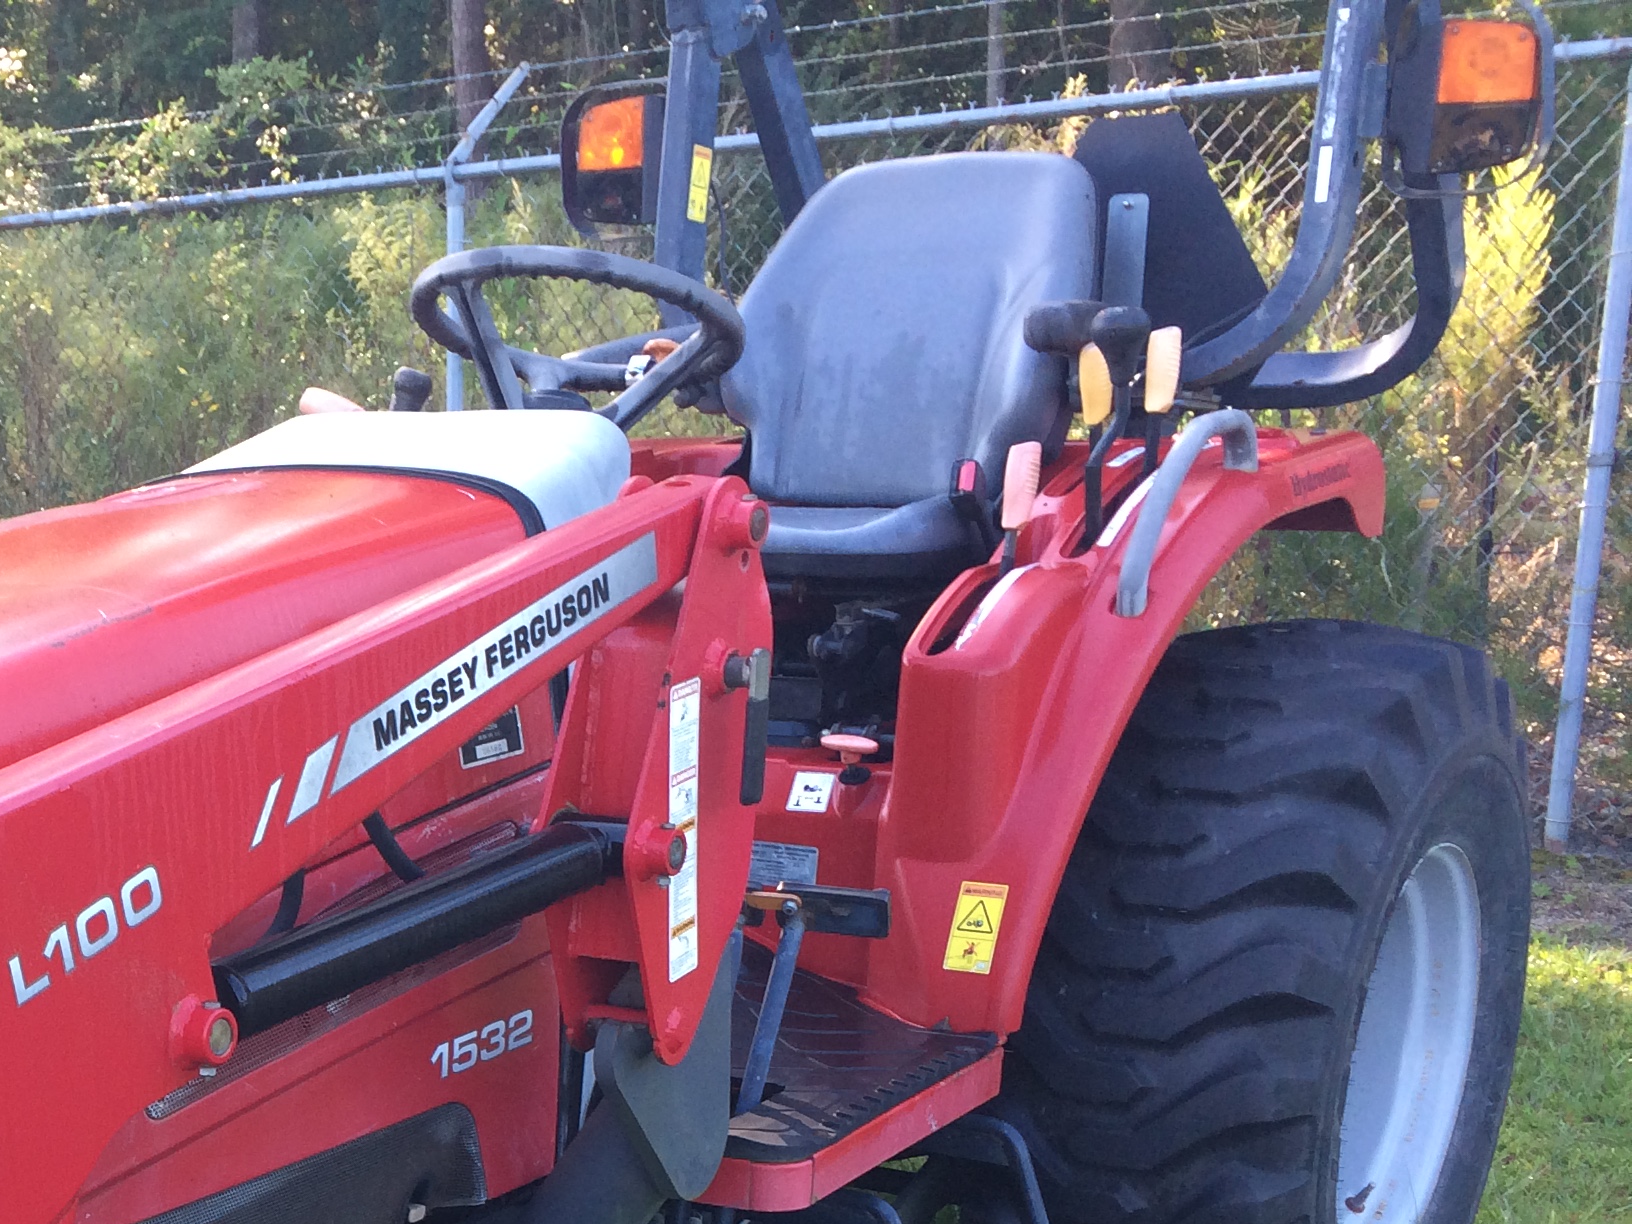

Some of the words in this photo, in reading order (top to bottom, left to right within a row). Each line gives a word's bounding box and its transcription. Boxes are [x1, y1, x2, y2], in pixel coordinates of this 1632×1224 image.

[372, 655, 478, 751] MASSEY
[485, 572, 611, 678] FERGUSON
[8, 864, 163, 1007] L100
[430, 1008, 533, 1079] 1532
